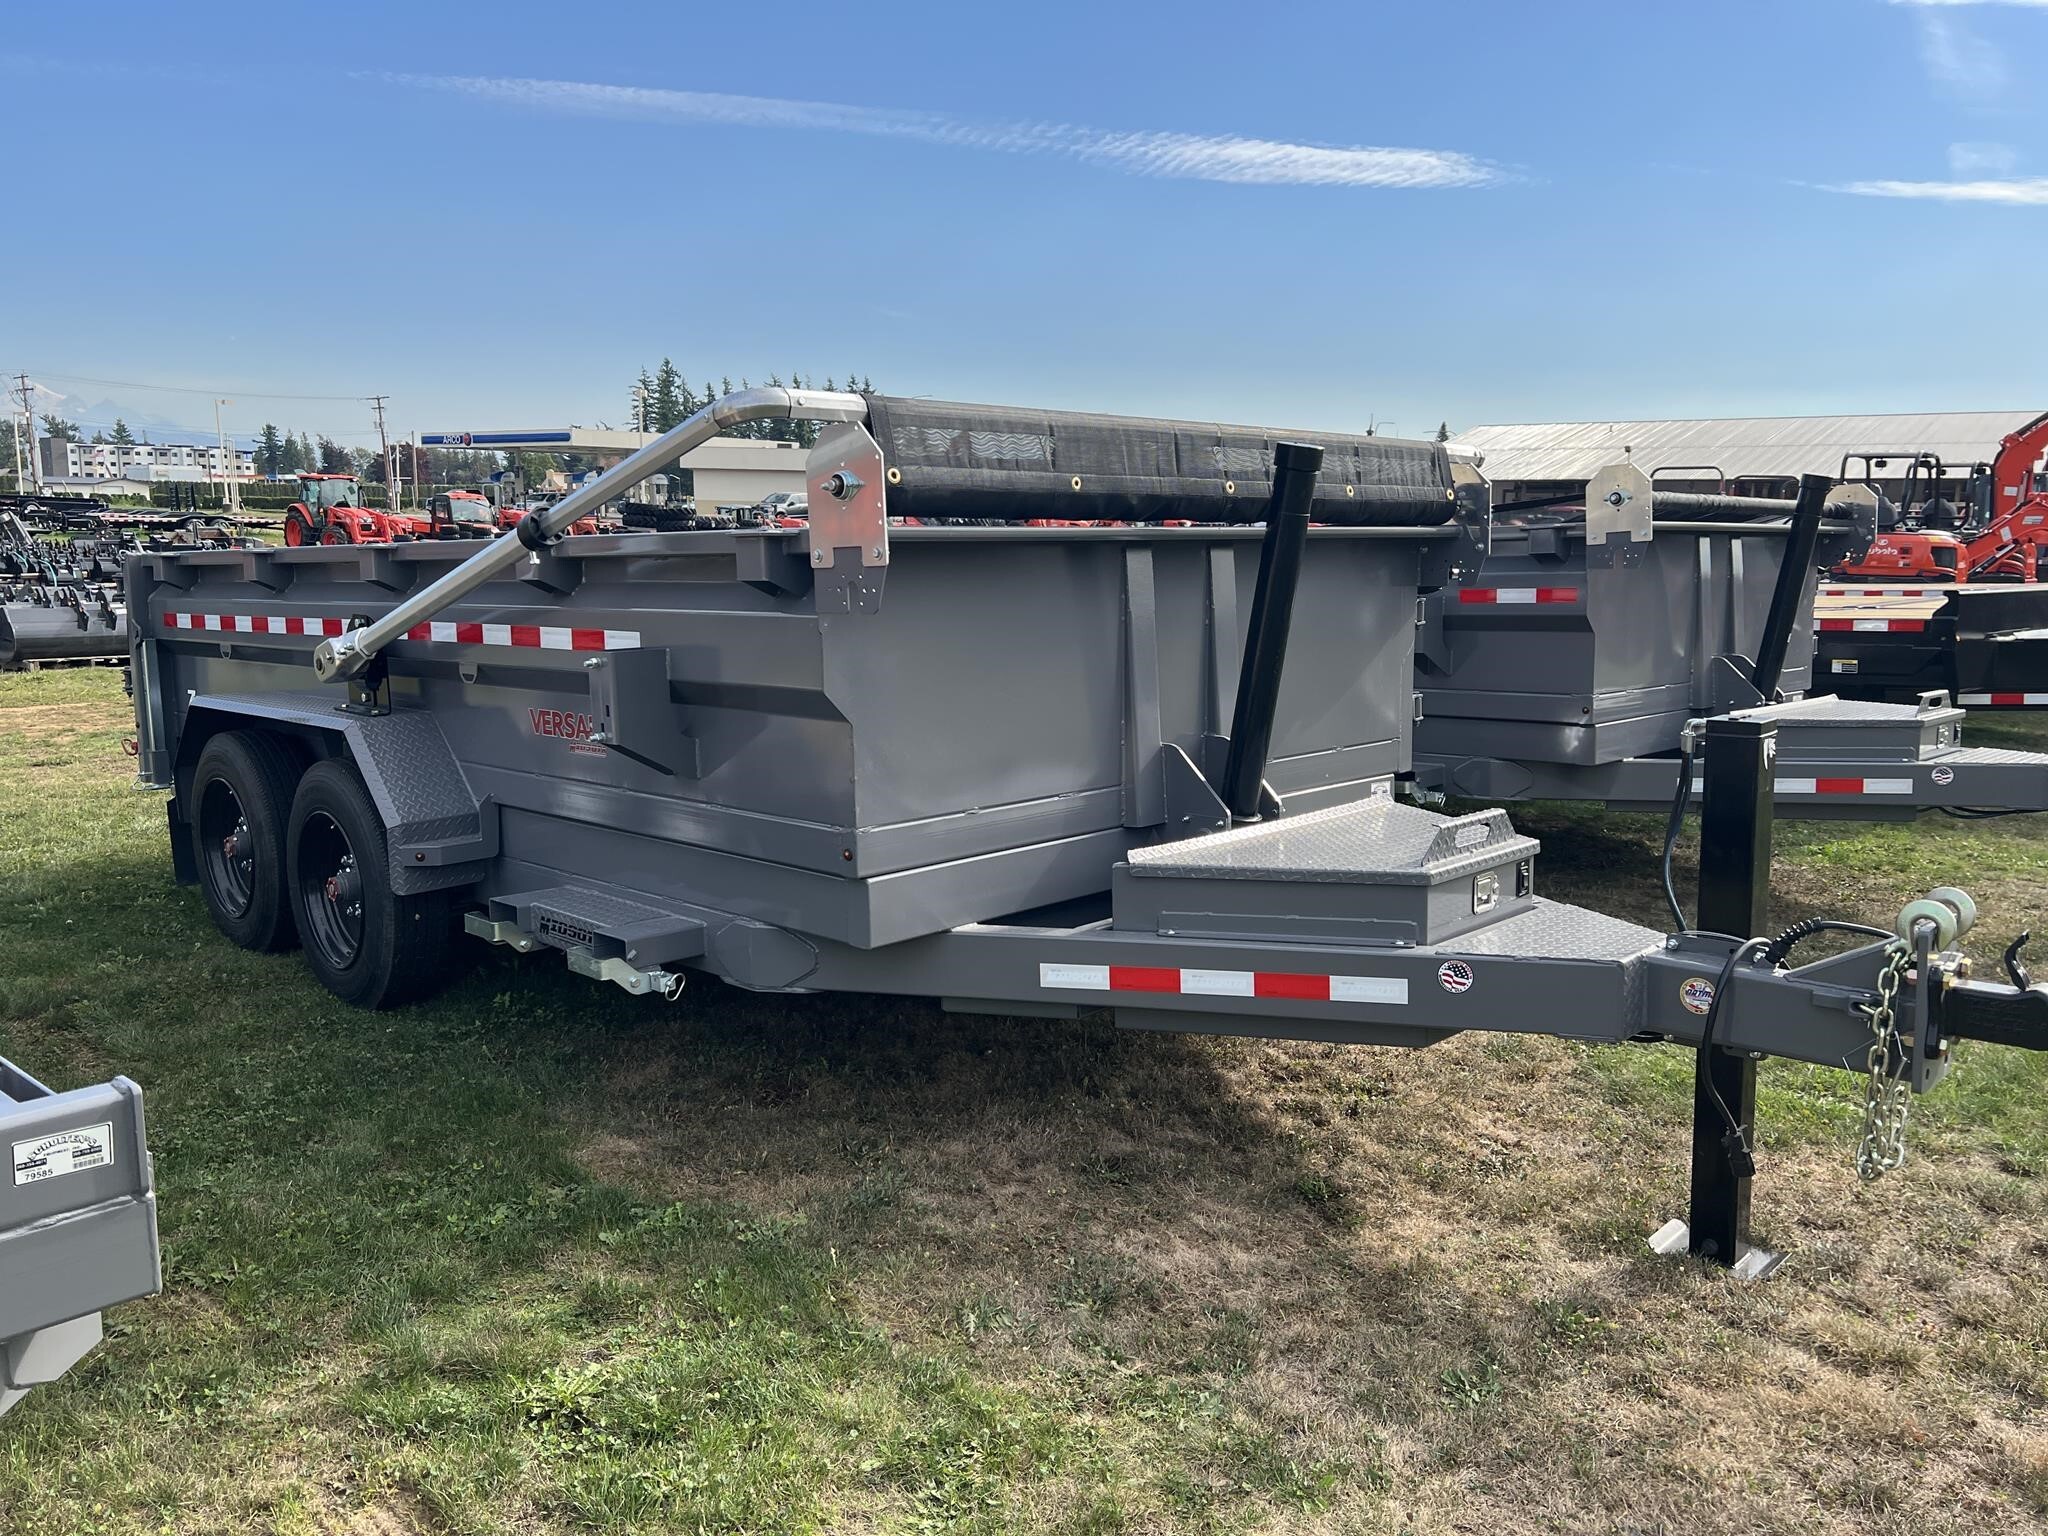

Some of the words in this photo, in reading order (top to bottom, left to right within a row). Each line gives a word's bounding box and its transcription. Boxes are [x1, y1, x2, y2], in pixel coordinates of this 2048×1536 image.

[442, 435, 461, 444] ARCO
[1867, 547, 1898, 555] ubota
[528, 707, 593, 742] VERSA
[540, 915, 593, 945] MIDSOT
[24, 1168, 54, 1181] 79585
